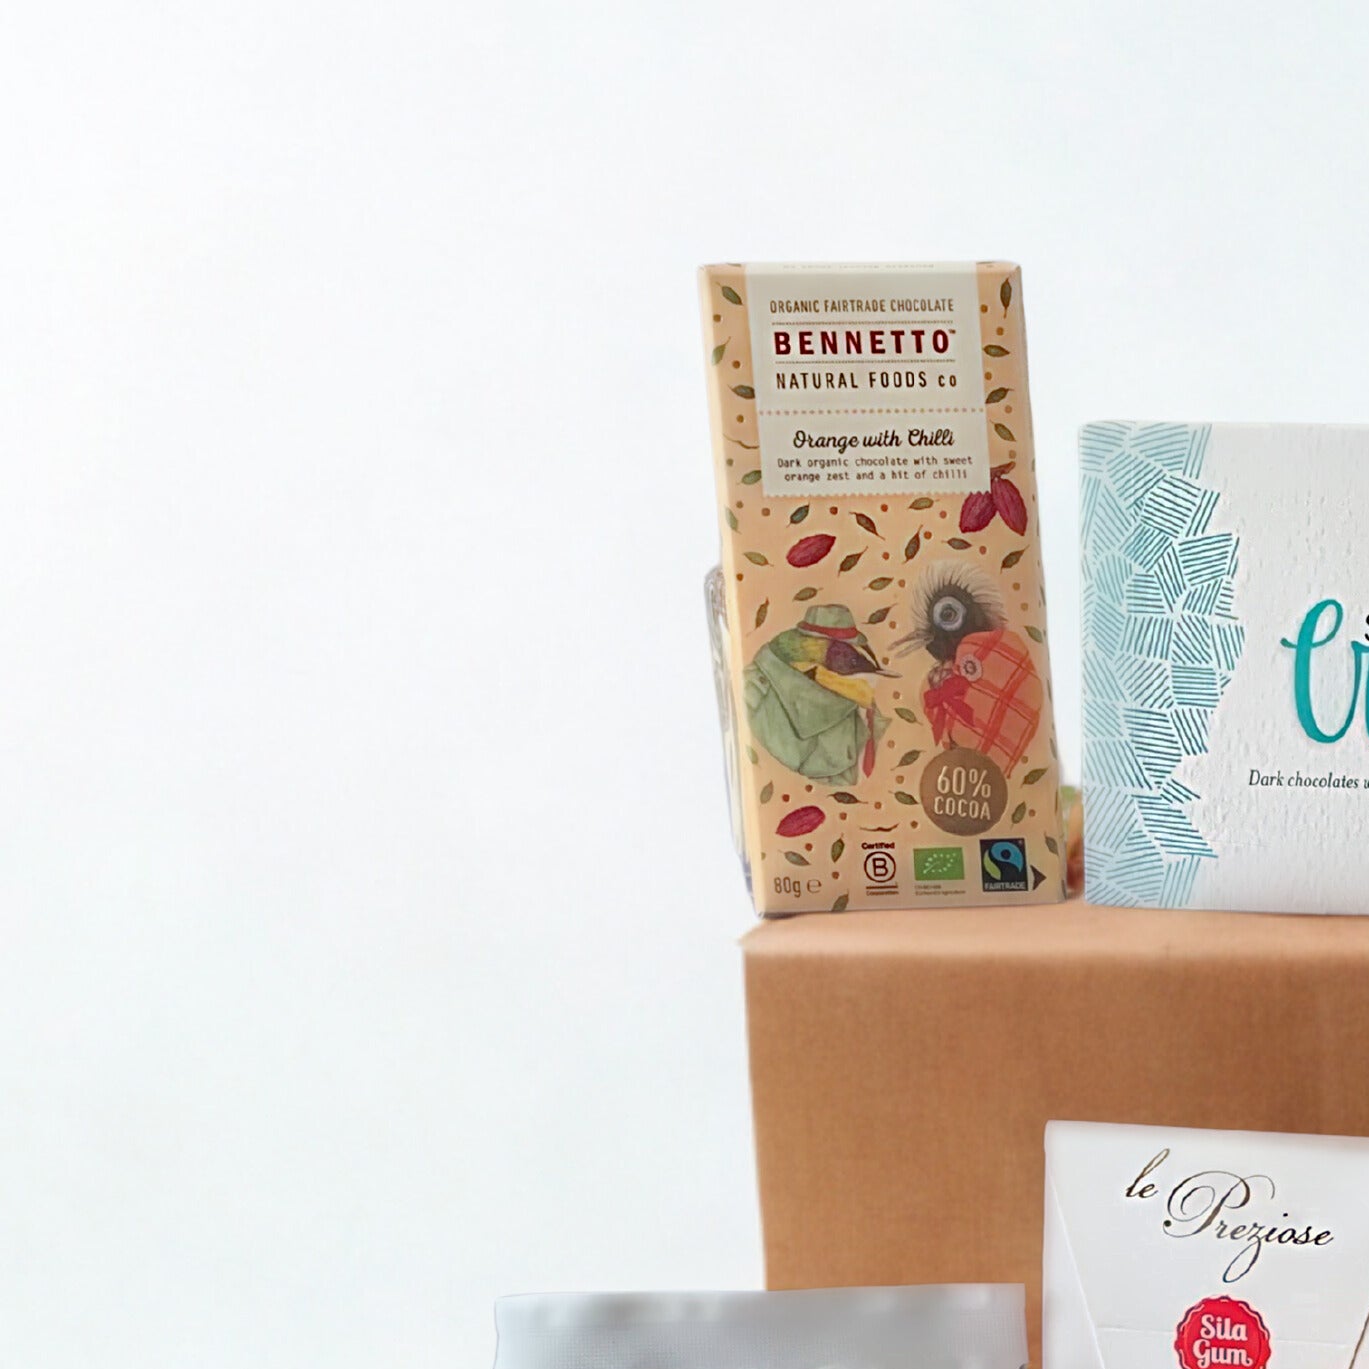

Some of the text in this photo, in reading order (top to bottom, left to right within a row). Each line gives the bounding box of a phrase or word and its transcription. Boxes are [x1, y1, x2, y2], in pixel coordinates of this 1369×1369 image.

[769, 298, 954, 314] ORGANIC FAIRTRADE CHOCOLATE
[776, 372, 859, 389] NATURAL
[869, 371, 927, 388] FOODS
[793, 428, 955, 454] Orange with Chilli
[777, 456, 974, 469] Dark organic chocolate with sweet
[785, 472, 820, 482] orange
[827, 472, 850, 481] zest
[856, 470, 874, 480] and
[891, 470, 909, 479] hit
[914, 470, 926, 479] of
[933, 469, 967, 479] chilli
[936, 766, 992, 798] 60%
[1248, 769, 1285, 787] Dark
[1287, 770, 1359, 790] chocolates
[934, 796, 992, 820] COCOA
[860, 842, 896, 850] Certified
[872, 857, 888, 877] B
[773, 876, 801, 898] 80g
[984, 882, 1026, 891] FAIRTRADE
[1126, 1148, 1171, 1199] le
[1163, 1170, 1334, 1284] Preziose
[1200, 1314, 1248, 1341] Sila
[1192, 1338, 1253, 1369] Gum
